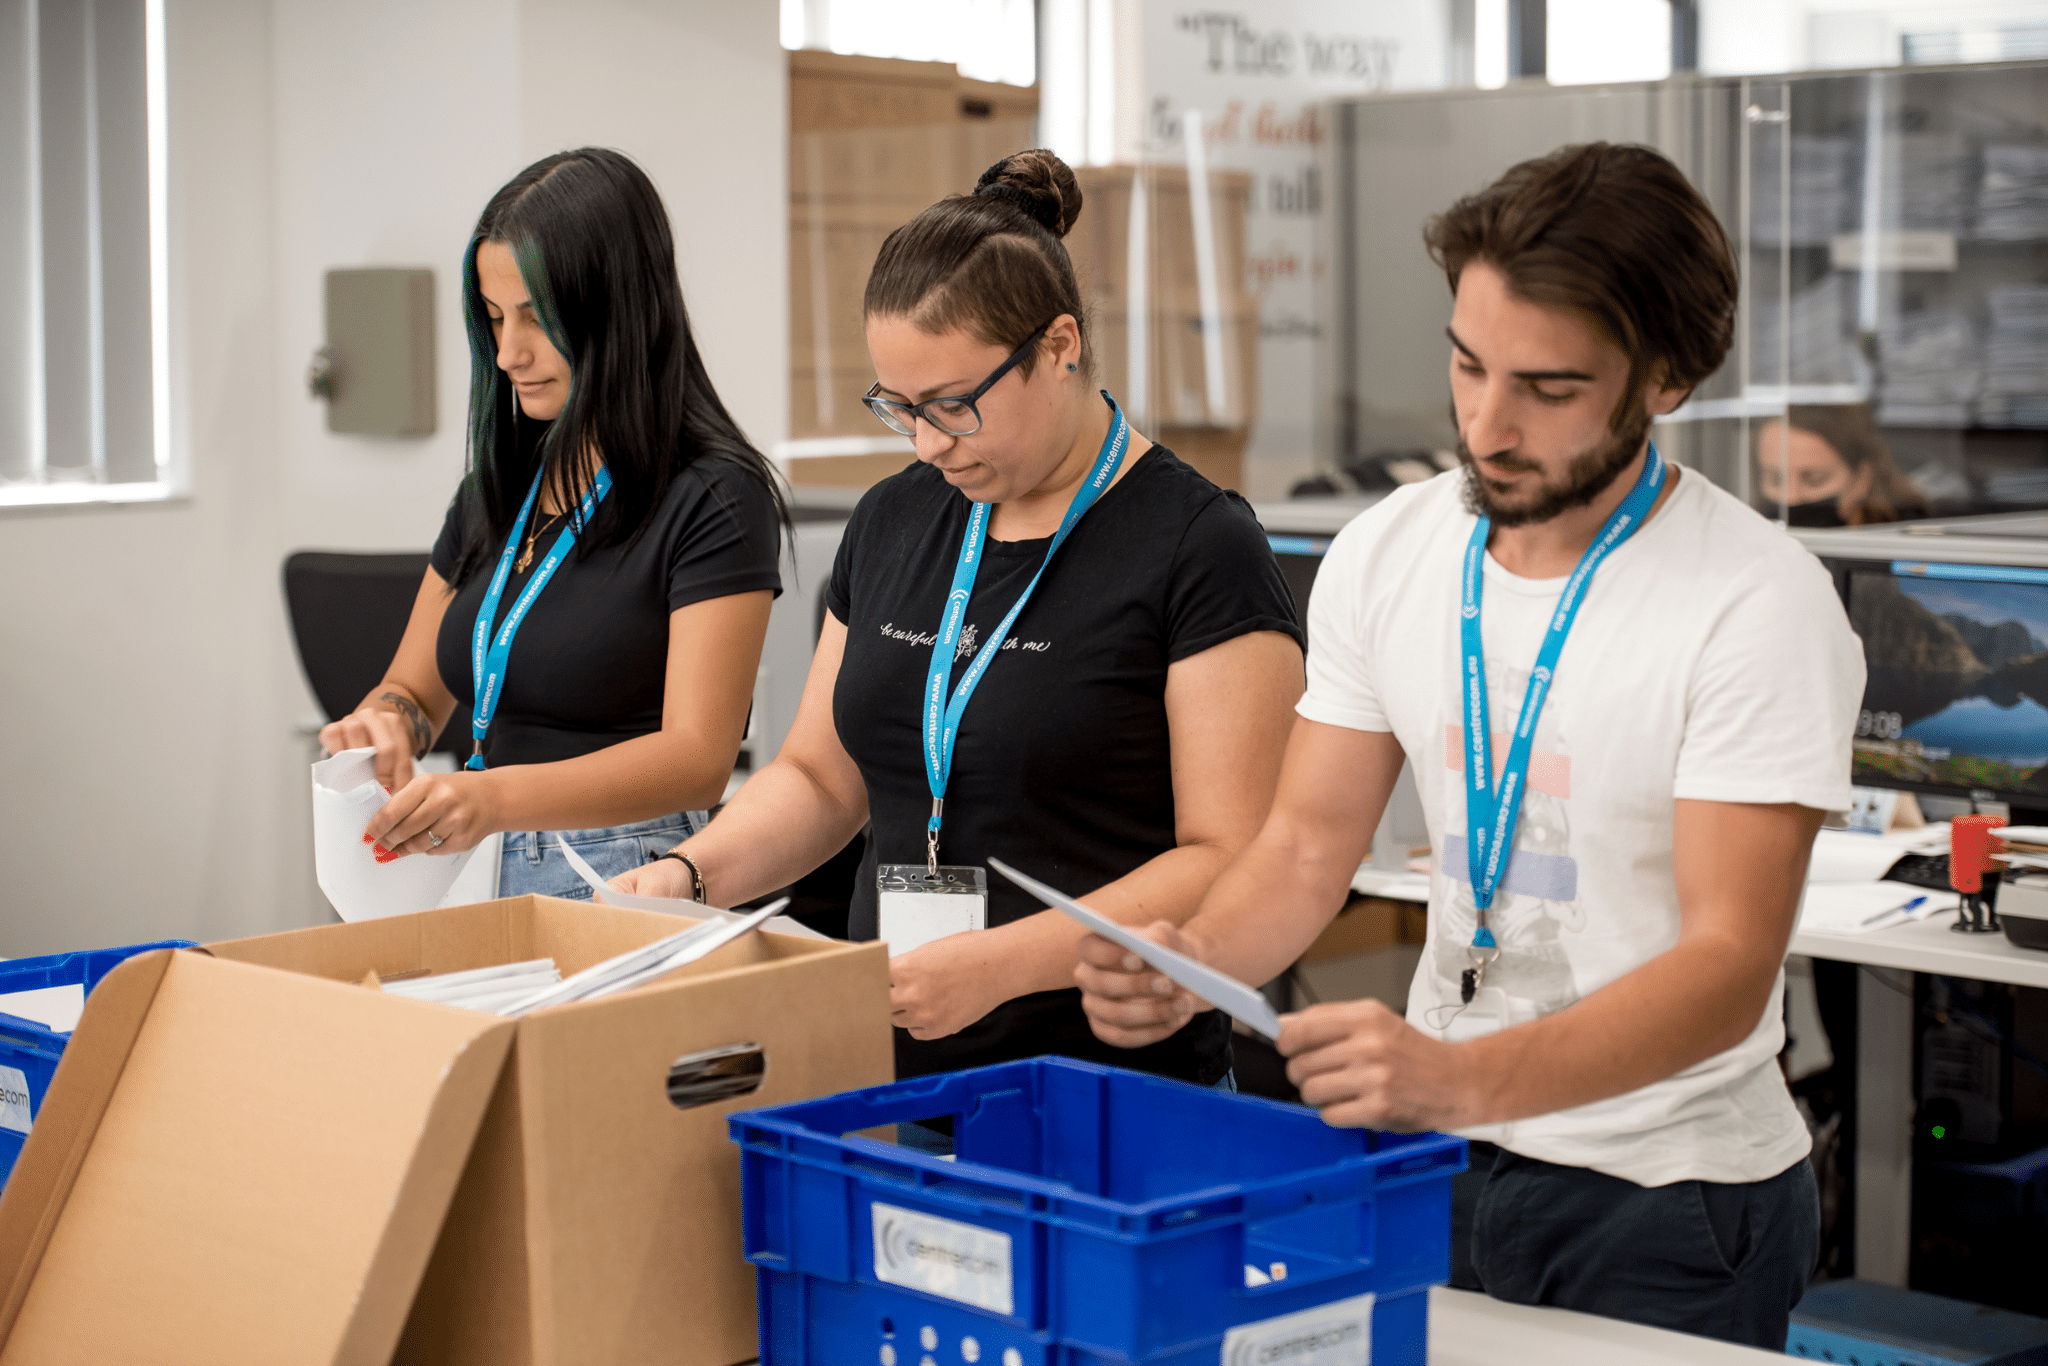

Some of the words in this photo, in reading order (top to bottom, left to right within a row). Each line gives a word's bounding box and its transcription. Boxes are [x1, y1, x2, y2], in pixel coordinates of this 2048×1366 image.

[499, 555, 556, 646] www.centrecom.eu
[943, 601, 961, 644] centrecom
[892, 630, 938, 647] careful
[1022, 641, 1051, 652] me
[480, 673, 497, 718] centrecom
[1468, 655, 1486, 791] www.centrecom.eu
